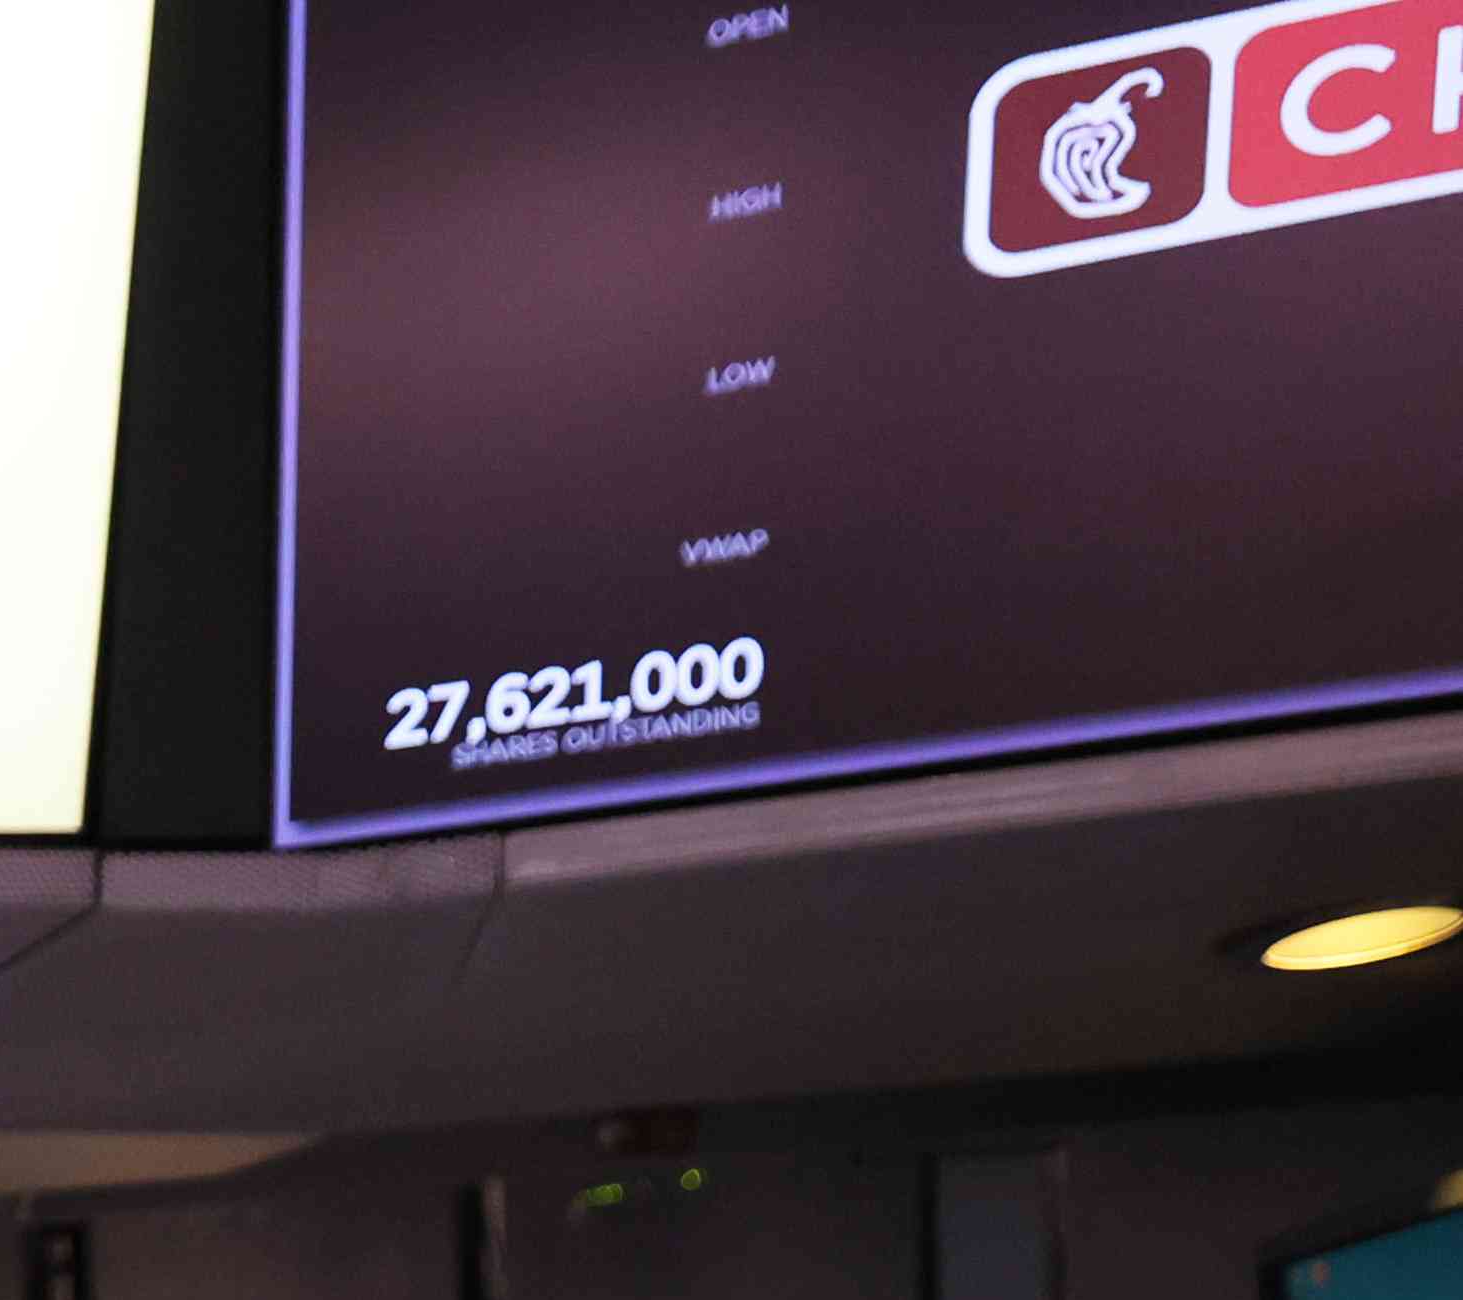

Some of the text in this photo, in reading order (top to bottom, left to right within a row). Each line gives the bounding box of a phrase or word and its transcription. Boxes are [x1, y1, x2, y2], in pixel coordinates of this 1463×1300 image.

[707, 4, 789, 48] OPEN
[710, 183, 783, 222] HIGH
[705, 356, 776, 394] LOW
[681, 528, 770, 566] VWAP
[385, 637, 765, 751] 27,621,000
[453, 725, 558, 769] SHARES
